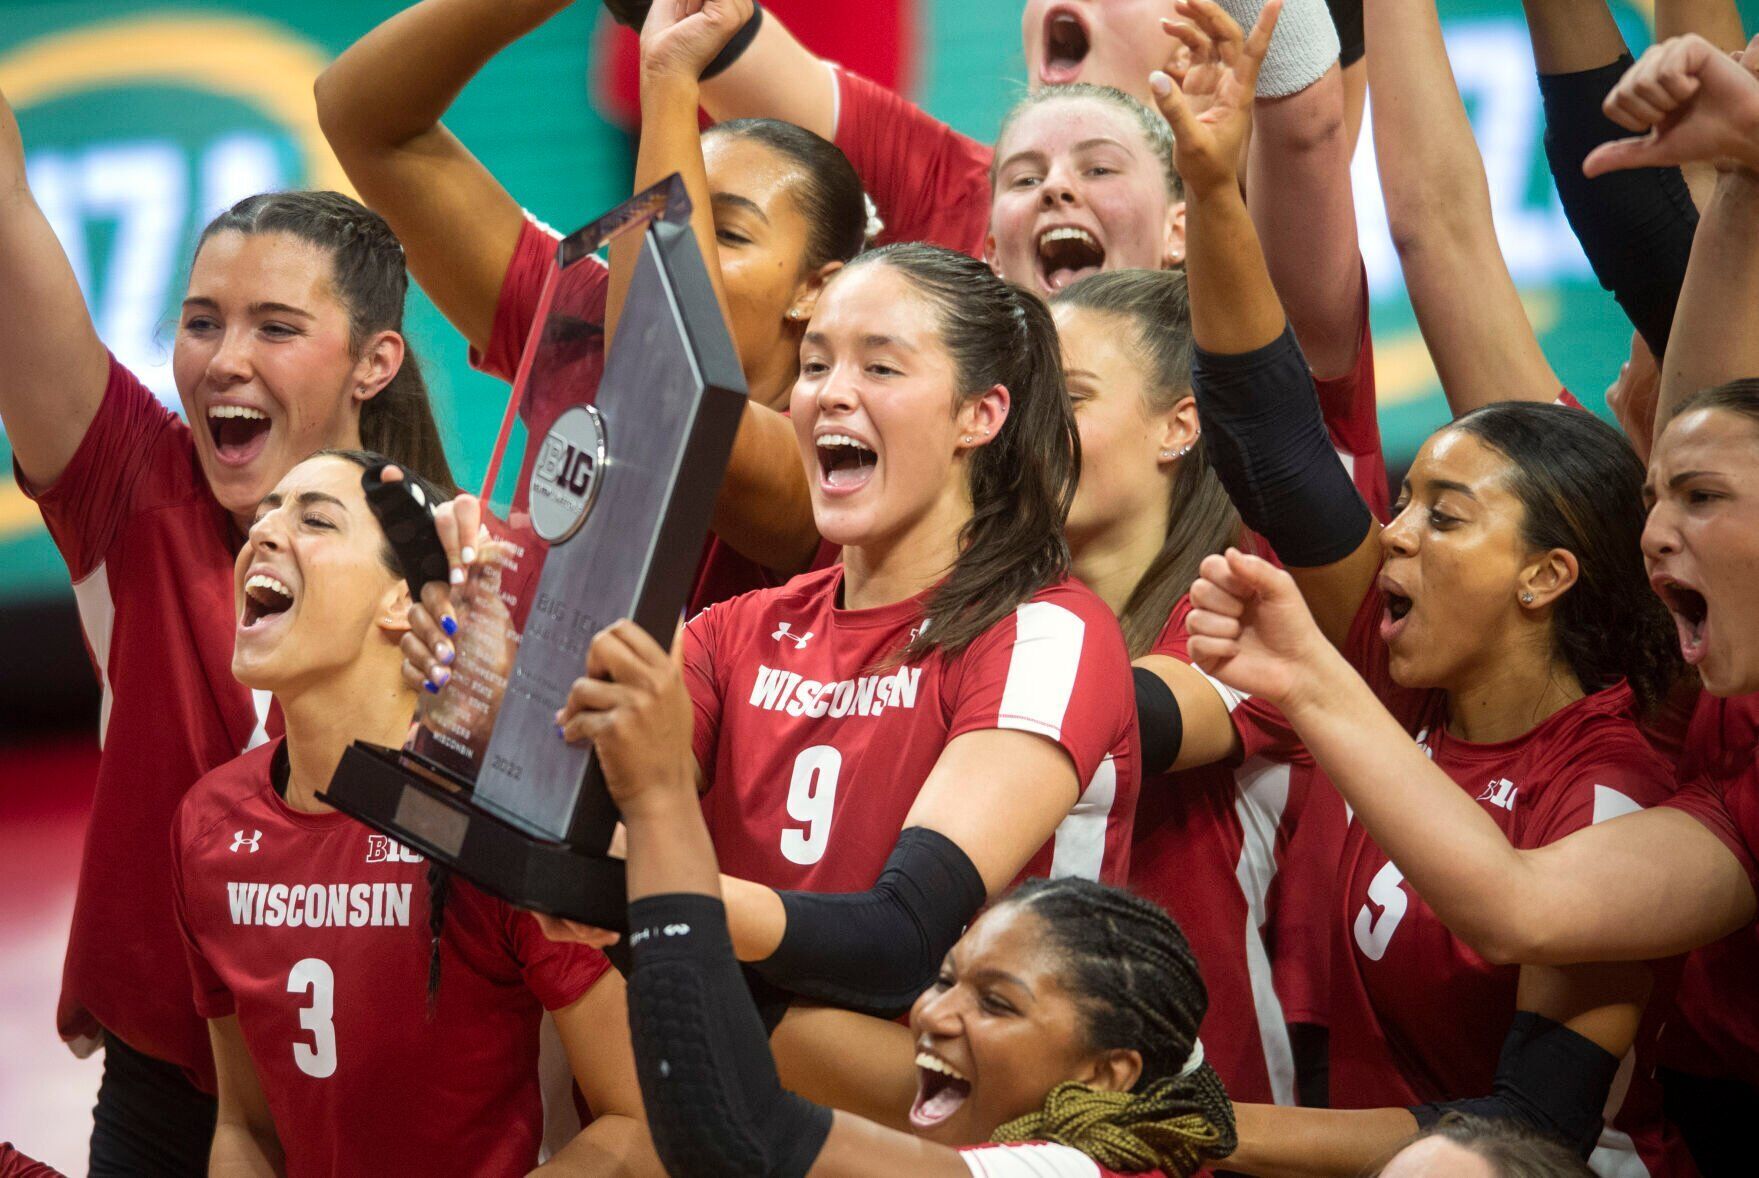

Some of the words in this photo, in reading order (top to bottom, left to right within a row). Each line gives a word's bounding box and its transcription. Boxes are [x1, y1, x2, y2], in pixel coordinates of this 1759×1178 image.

[780, 745, 842, 865] 9
[227, 881, 413, 928] WISCONSIN
[287, 958, 337, 1078] 3
